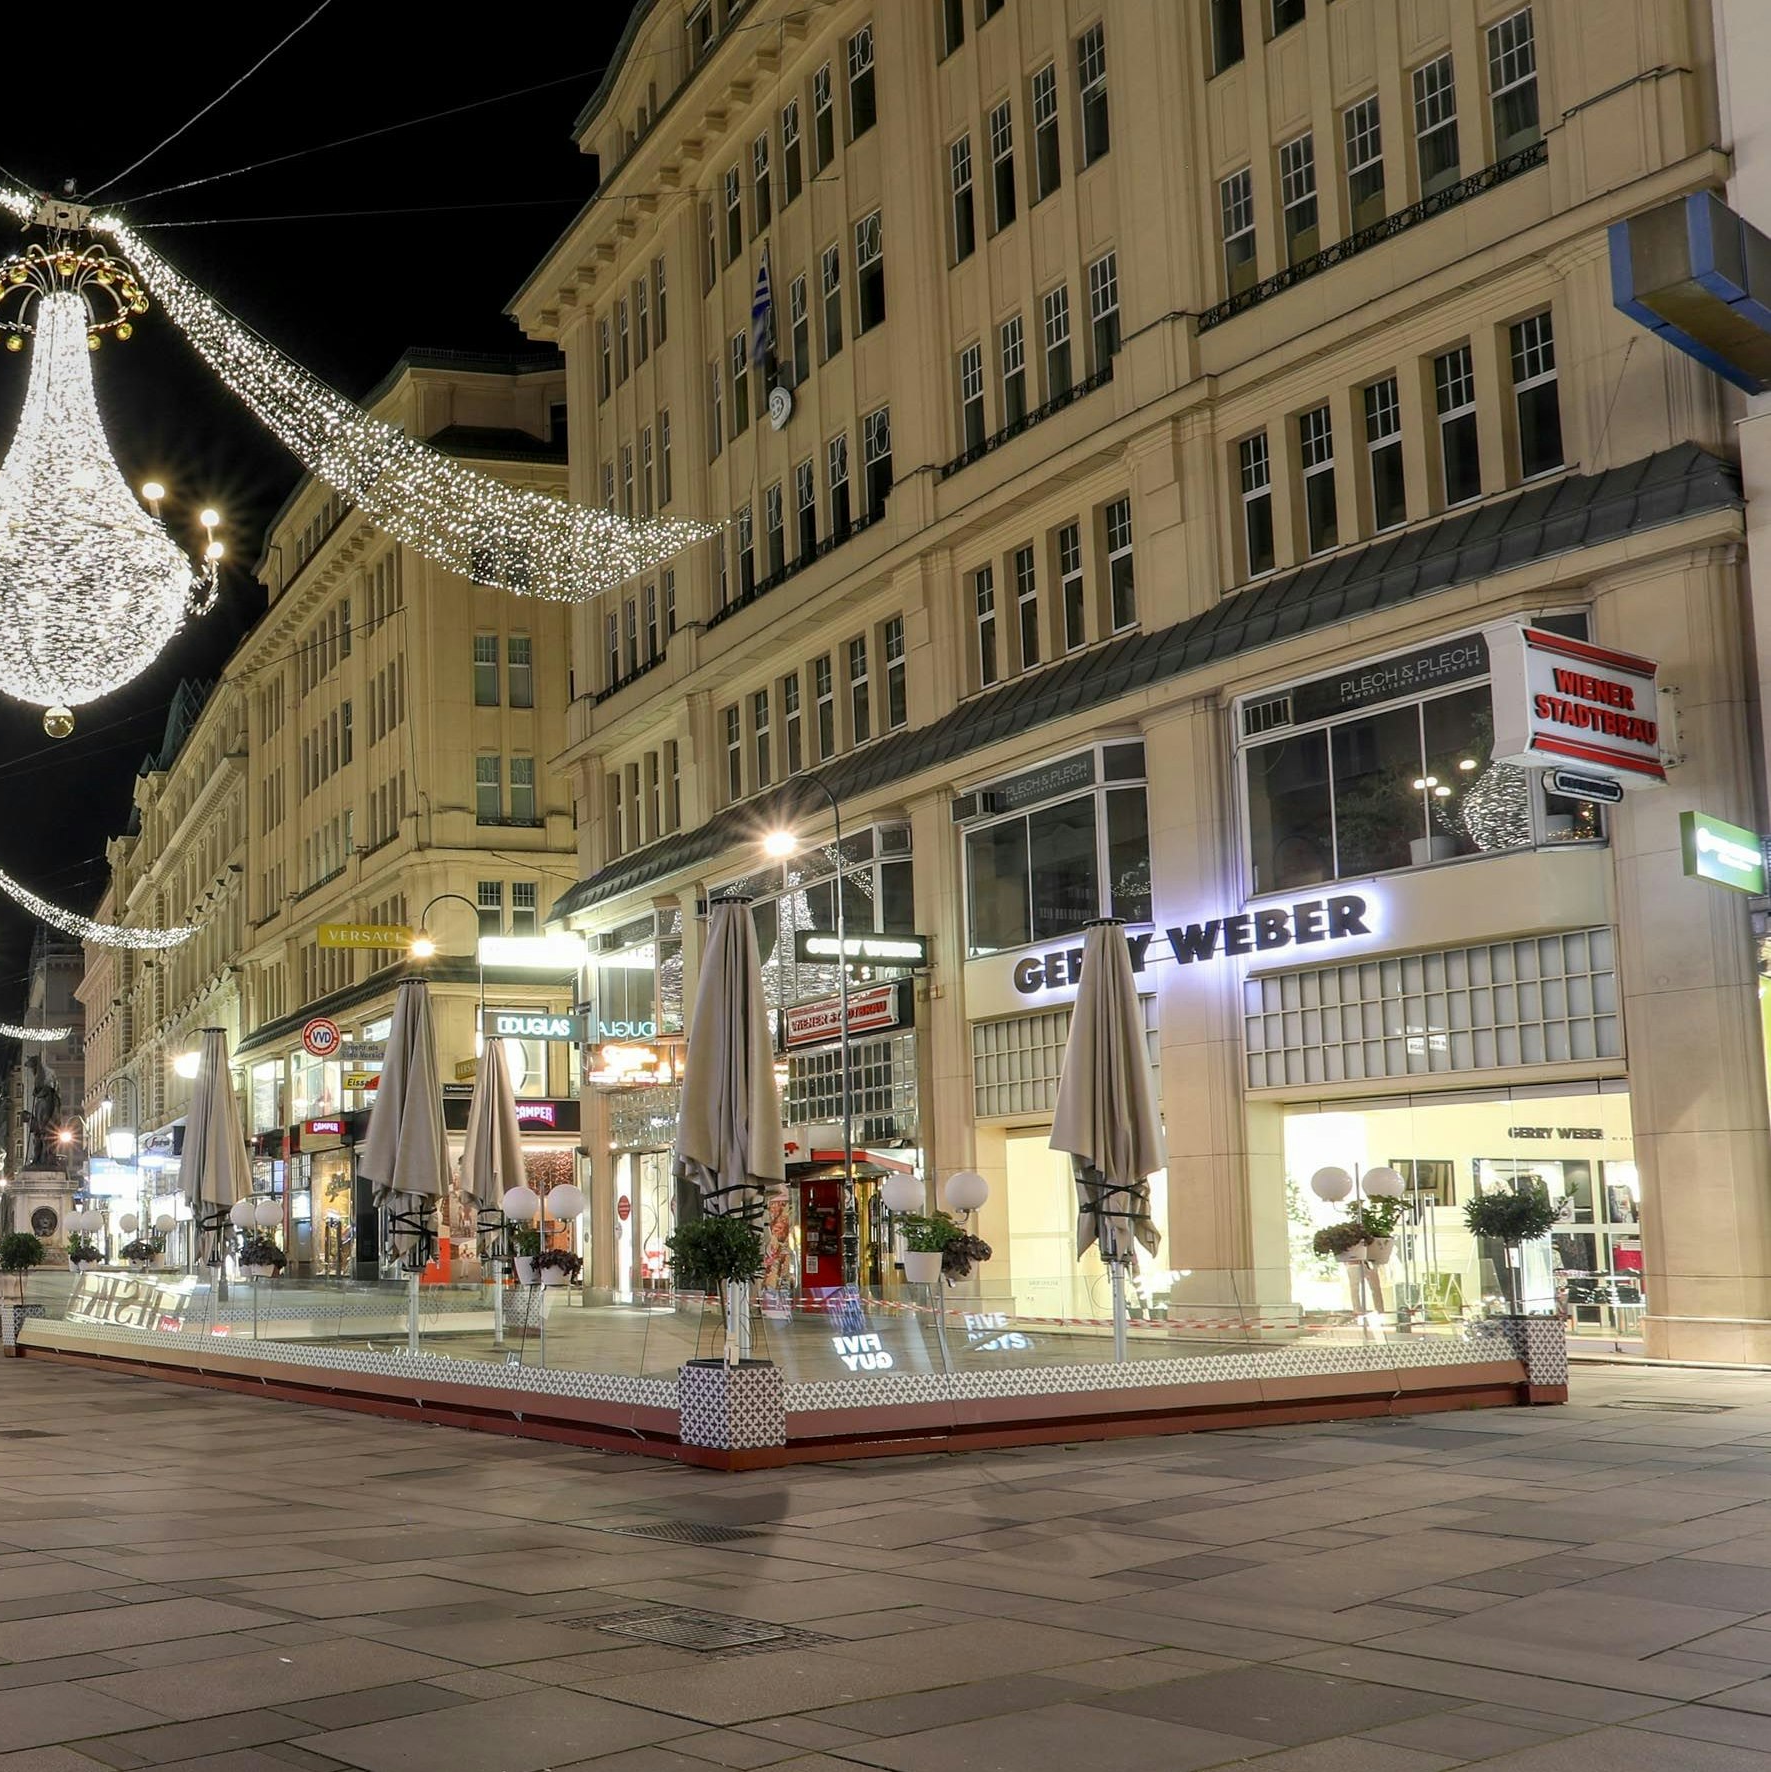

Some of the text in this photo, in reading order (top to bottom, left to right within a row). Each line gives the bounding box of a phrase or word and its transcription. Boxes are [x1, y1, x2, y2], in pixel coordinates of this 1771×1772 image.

[1340, 644, 1479, 696] PLECH & PLECH
[1553, 668, 1635, 710] WIENER
[1005, 777, 1040, 797] PLECH
[1050, 760, 1088, 782] PLECH
[328, 929, 404, 943] VERSACE
[1013, 894, 1372, 995] GERY WEBER
[497, 1016, 571, 1037] DOUGLAS
[791, 1013, 828, 1033] WIENER
[312, 1031, 332, 1044] VVD
[515, 1105, 553, 1122] CAMPER
[312, 1122, 339, 1132] CAMPER
[1508, 1127, 1604, 1140] GERRY WEBER
